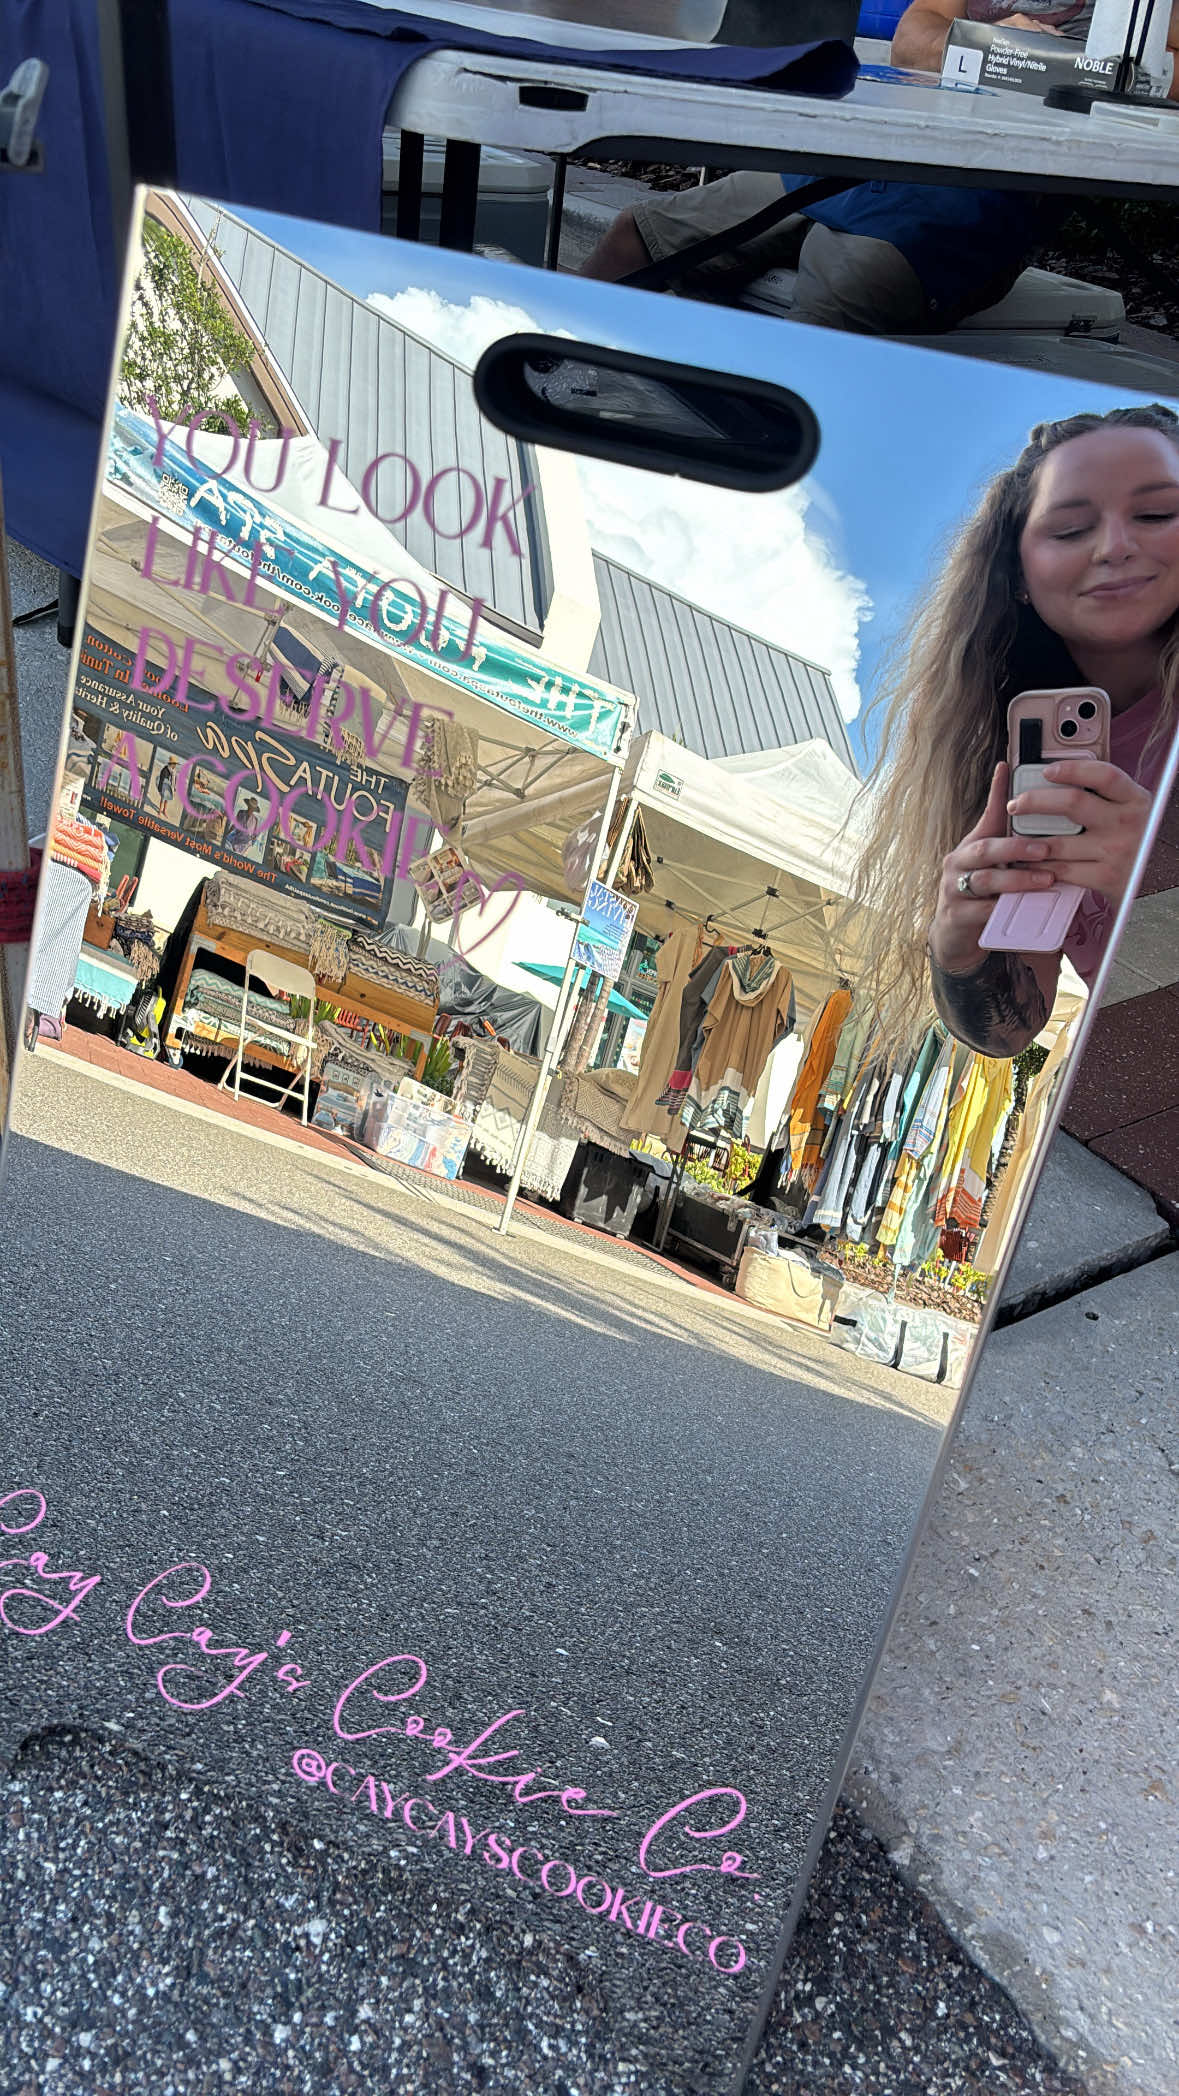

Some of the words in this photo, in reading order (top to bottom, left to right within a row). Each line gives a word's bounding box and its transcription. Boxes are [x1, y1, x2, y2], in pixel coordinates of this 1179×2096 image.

[958, 55, 967, 73] L
[985, 63, 1008, 75] Gloves
[987, 53, 1009, 66] Hybrid
[1010, 56, 1047, 72] Vinyl/Nitrile
[990, 44, 1029, 58] Powder-Free
[1074, 57, 1114, 75] NOBLE
[147, 394, 294, 493] YOU
[316, 437, 538, 560] LOOK
[140, 515, 297, 616] LIKE
[328, 558, 487, 664] YOU
[129, 625, 455, 778] DESERVE
[98, 730, 143, 802] A
[177, 755, 449, 884] COOKIE
[127, 1562, 311, 1710] Cay's
[334, 1654, 619, 1817] Cookie
[640, 1787, 761, 1901] Co.
[292, 1748, 747, 1974] @CAYCAYSCOOKIECO
